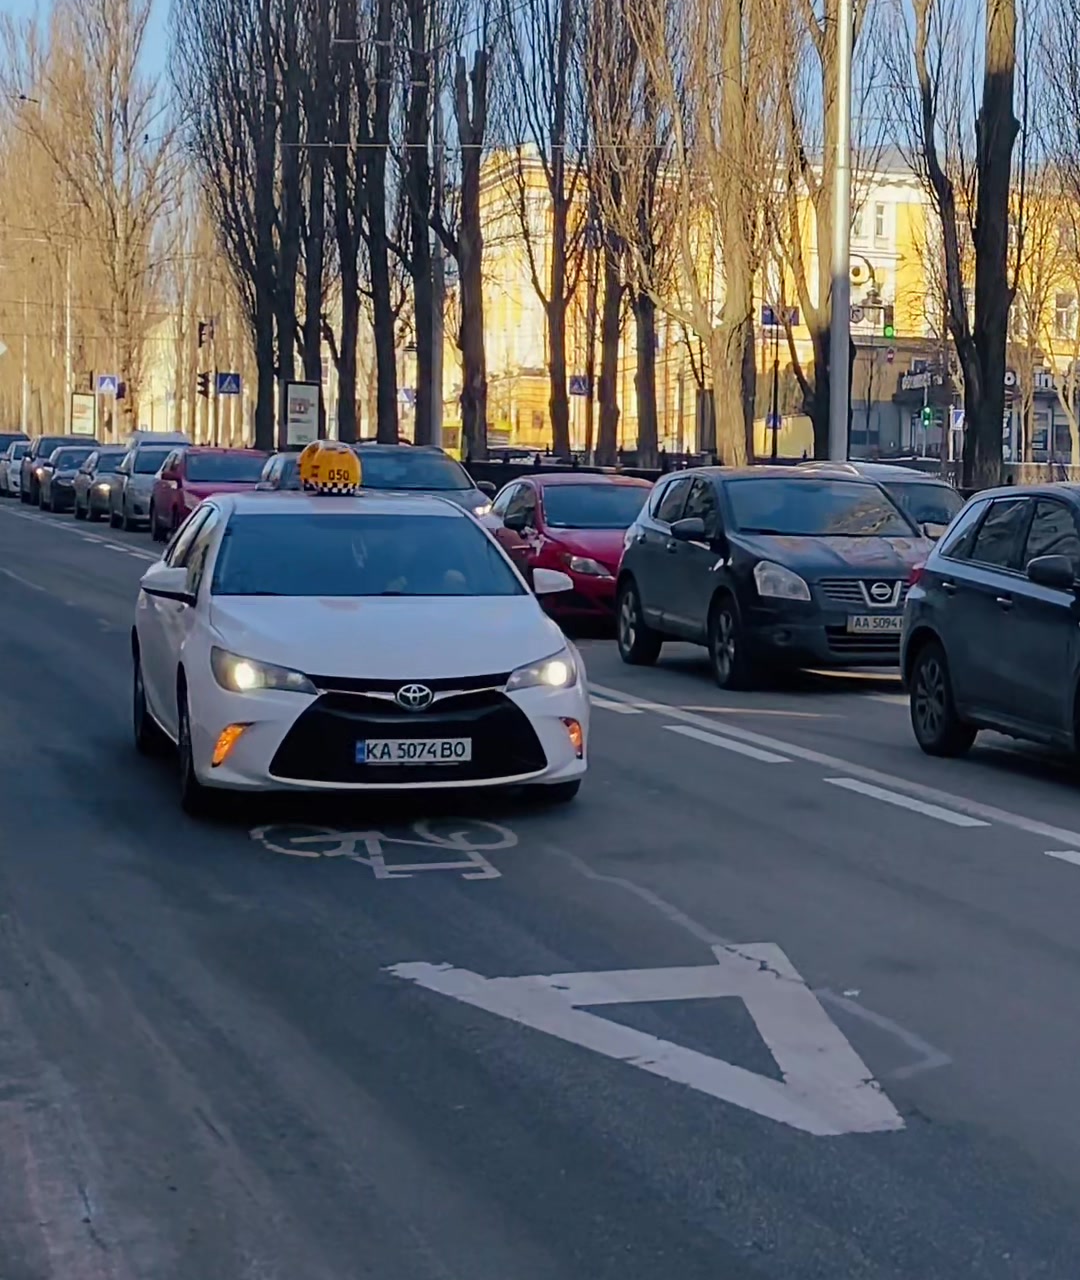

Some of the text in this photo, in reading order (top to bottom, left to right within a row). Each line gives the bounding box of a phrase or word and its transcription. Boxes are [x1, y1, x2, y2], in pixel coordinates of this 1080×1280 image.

[328, 469, 350, 481] 050
[366, 741, 466, 760] KA 5074 BO
